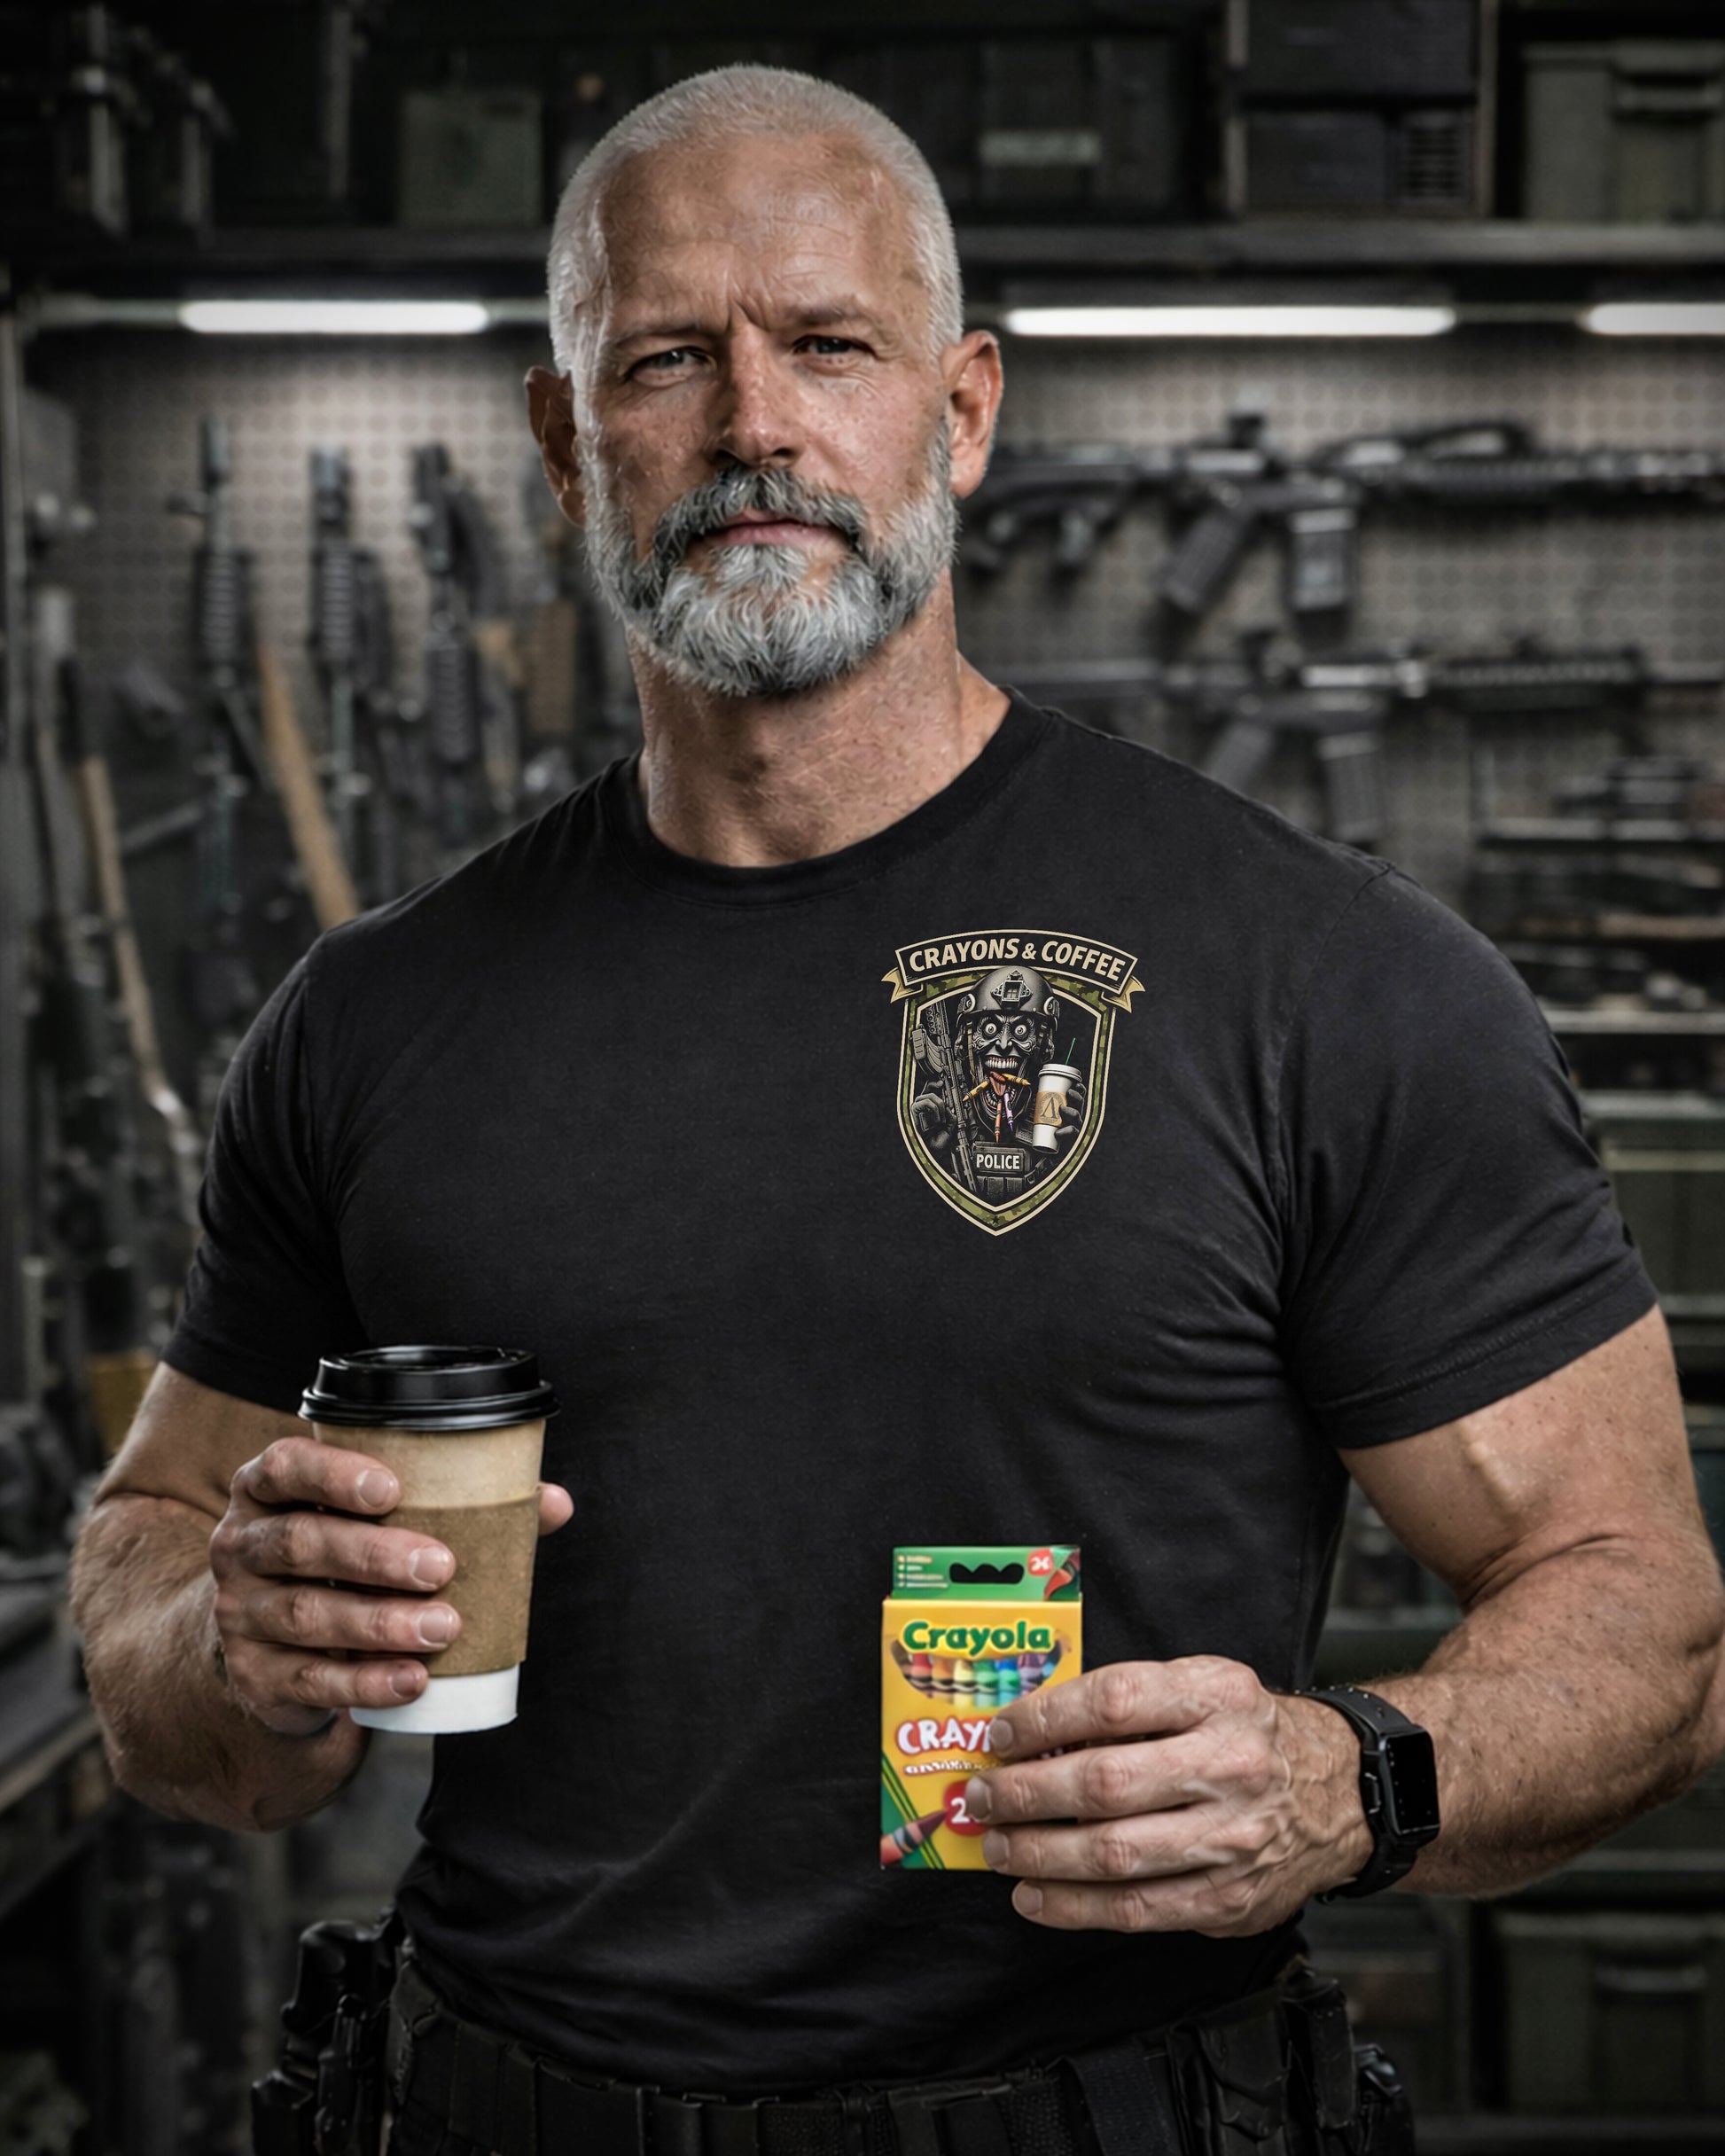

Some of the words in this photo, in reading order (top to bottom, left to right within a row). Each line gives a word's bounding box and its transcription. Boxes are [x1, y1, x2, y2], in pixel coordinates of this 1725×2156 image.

[909, 938, 1020, 973] CRAYONS
[1021, 942, 1037, 960] &
[1041, 941, 1127, 981] COFFEE
[976, 1153, 1020, 1170] POLICE
[902, 1621, 1051, 1656] Crayola
[897, 1717, 993, 1754] CRAY
[949, 1797, 973, 1824] 2
